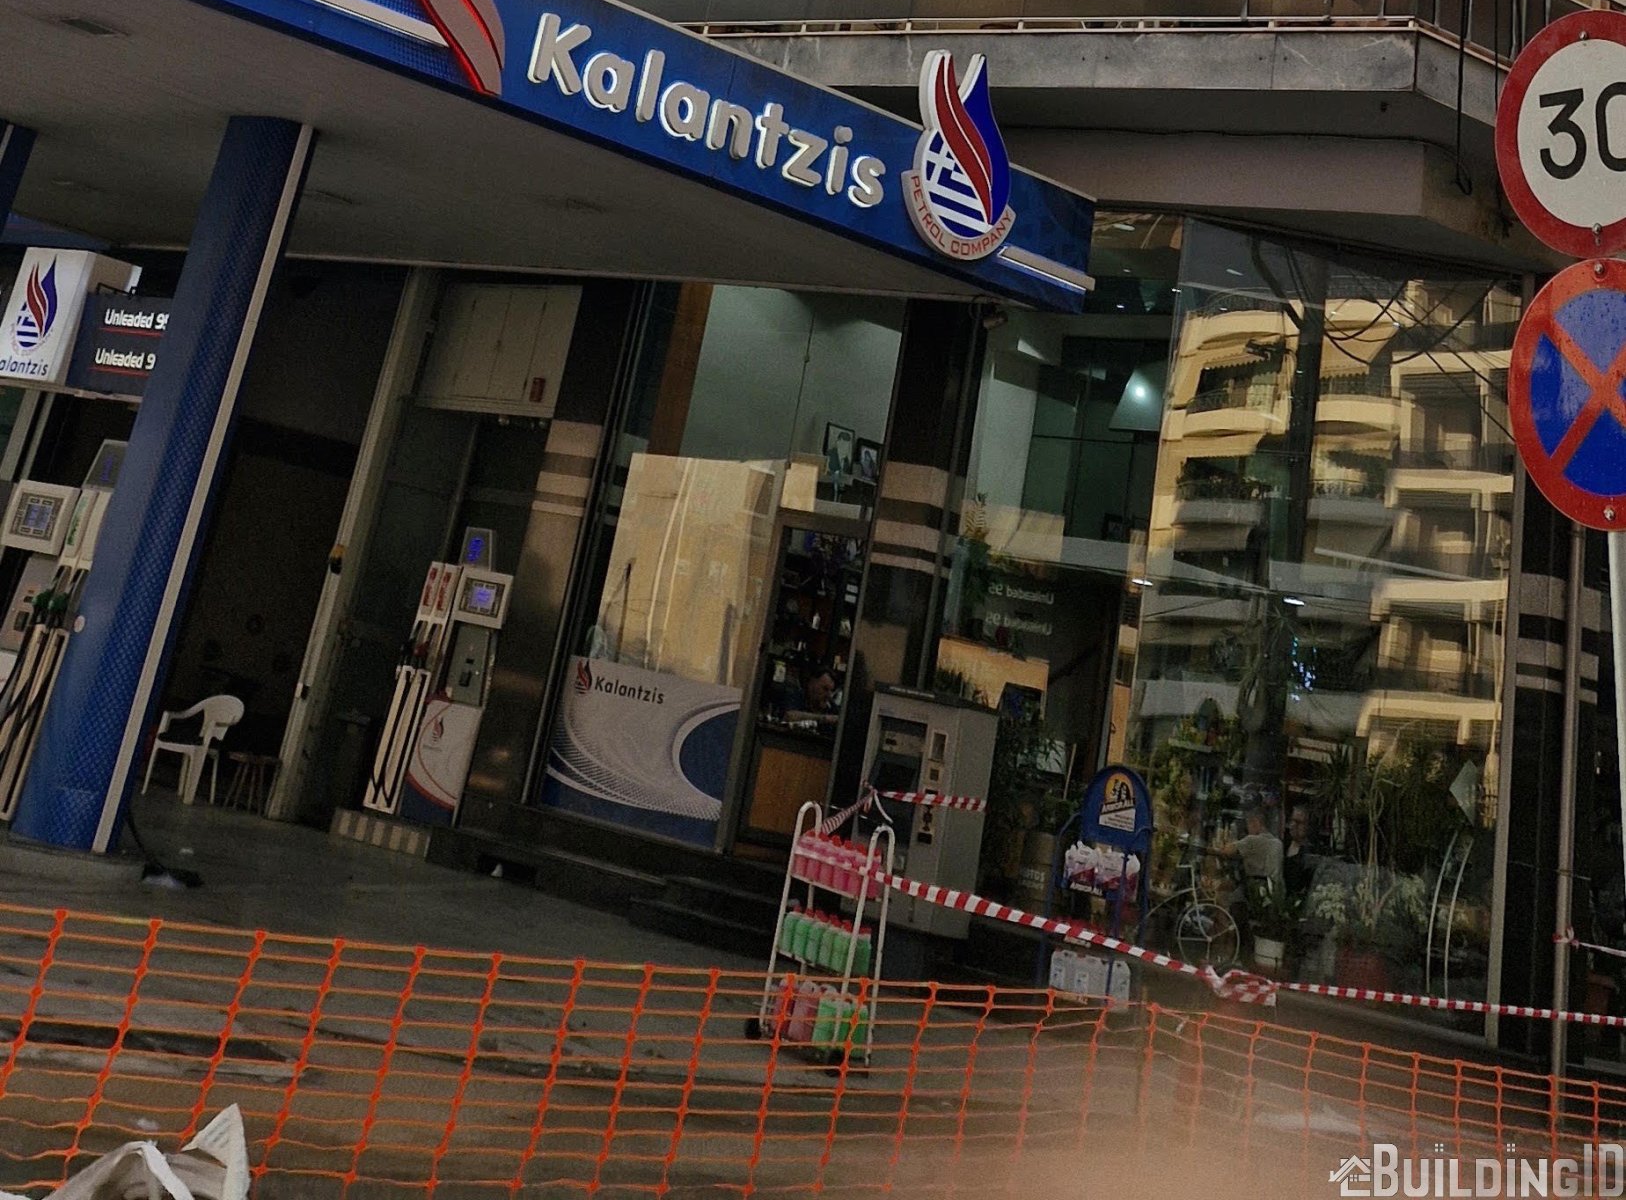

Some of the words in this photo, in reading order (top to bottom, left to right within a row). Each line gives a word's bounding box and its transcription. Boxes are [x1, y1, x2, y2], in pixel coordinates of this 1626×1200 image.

[527, 12, 887, 209] Kalantzis
[1538, 81, 1626, 180] 30
[910, 175, 946, 248] PETROL
[950, 214, 1013, 256] COMPANY
[104, 307, 154, 329] Unleaded
[95, 347, 145, 368] Unleaded
[594, 675, 665, 705] Kalantzis
